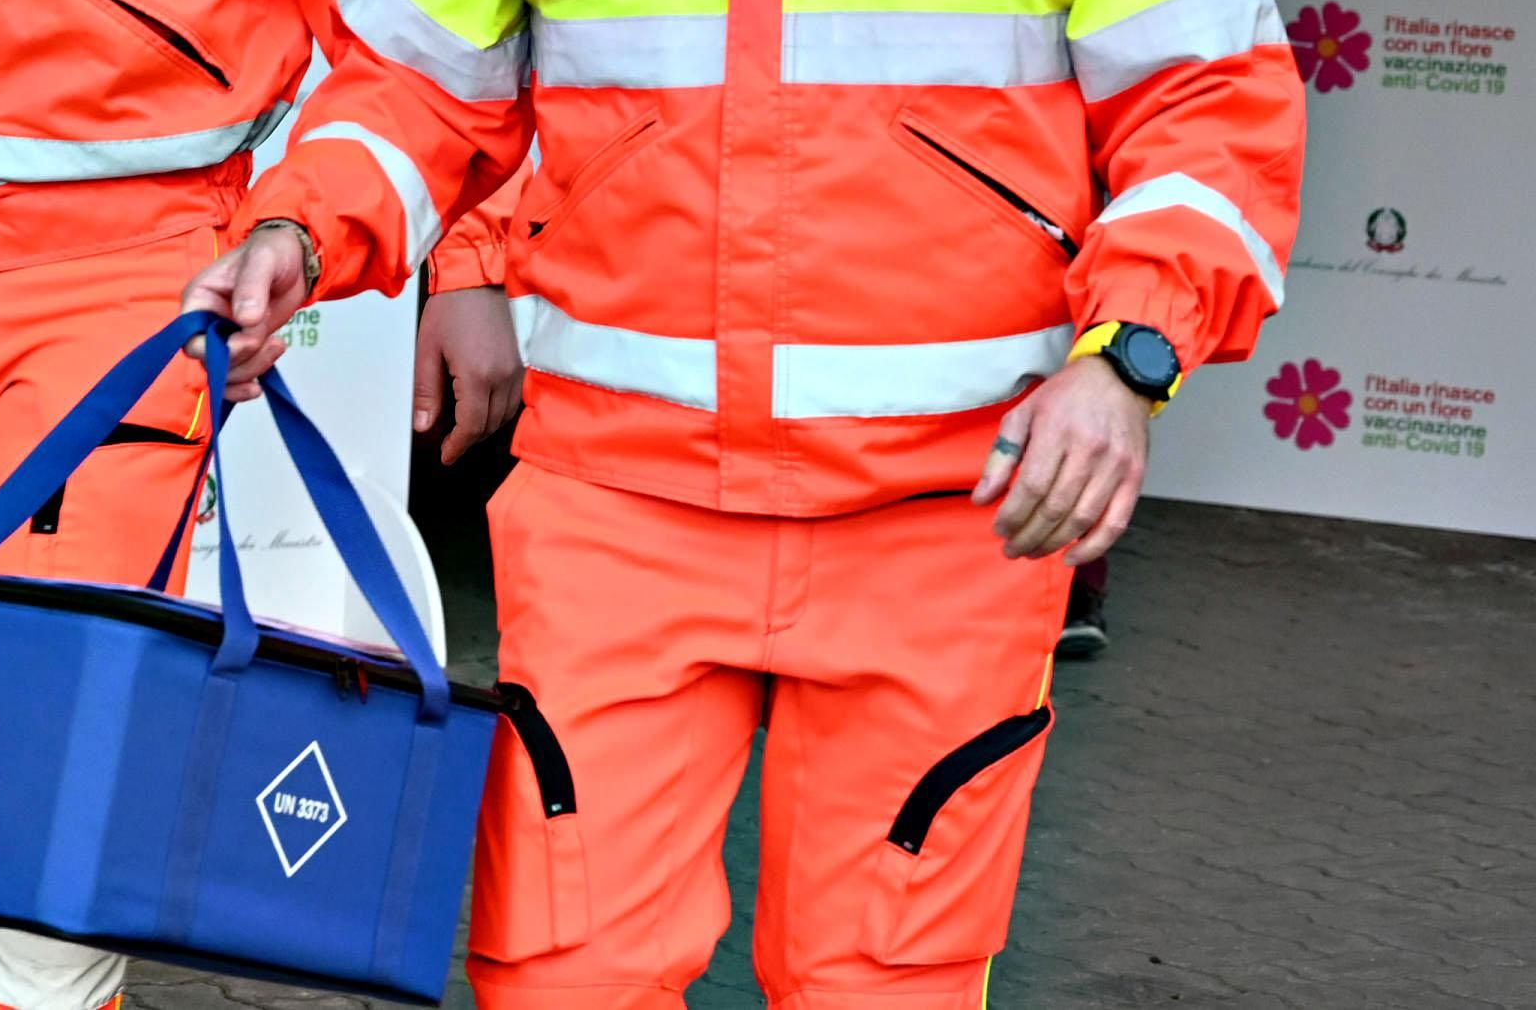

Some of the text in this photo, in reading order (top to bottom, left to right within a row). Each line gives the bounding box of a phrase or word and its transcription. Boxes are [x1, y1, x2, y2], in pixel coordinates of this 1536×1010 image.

[1384, 15, 1515, 40] l'Italia rinasce
[1384, 38, 1492, 58] con un fiore
[1383, 56, 1507, 77] vaccinazione
[1381, 73, 1505, 95] anti-Covid 19
[300, 328, 318, 347] 19
[1366, 374, 1495, 404] l'Italia rinasce
[1364, 397, 1473, 420] con un fiore
[1363, 414, 1487, 438] vaccinazione
[1362, 432, 1485, 457] anti-Covid 19
[274, 792, 330, 823] UN 3373
